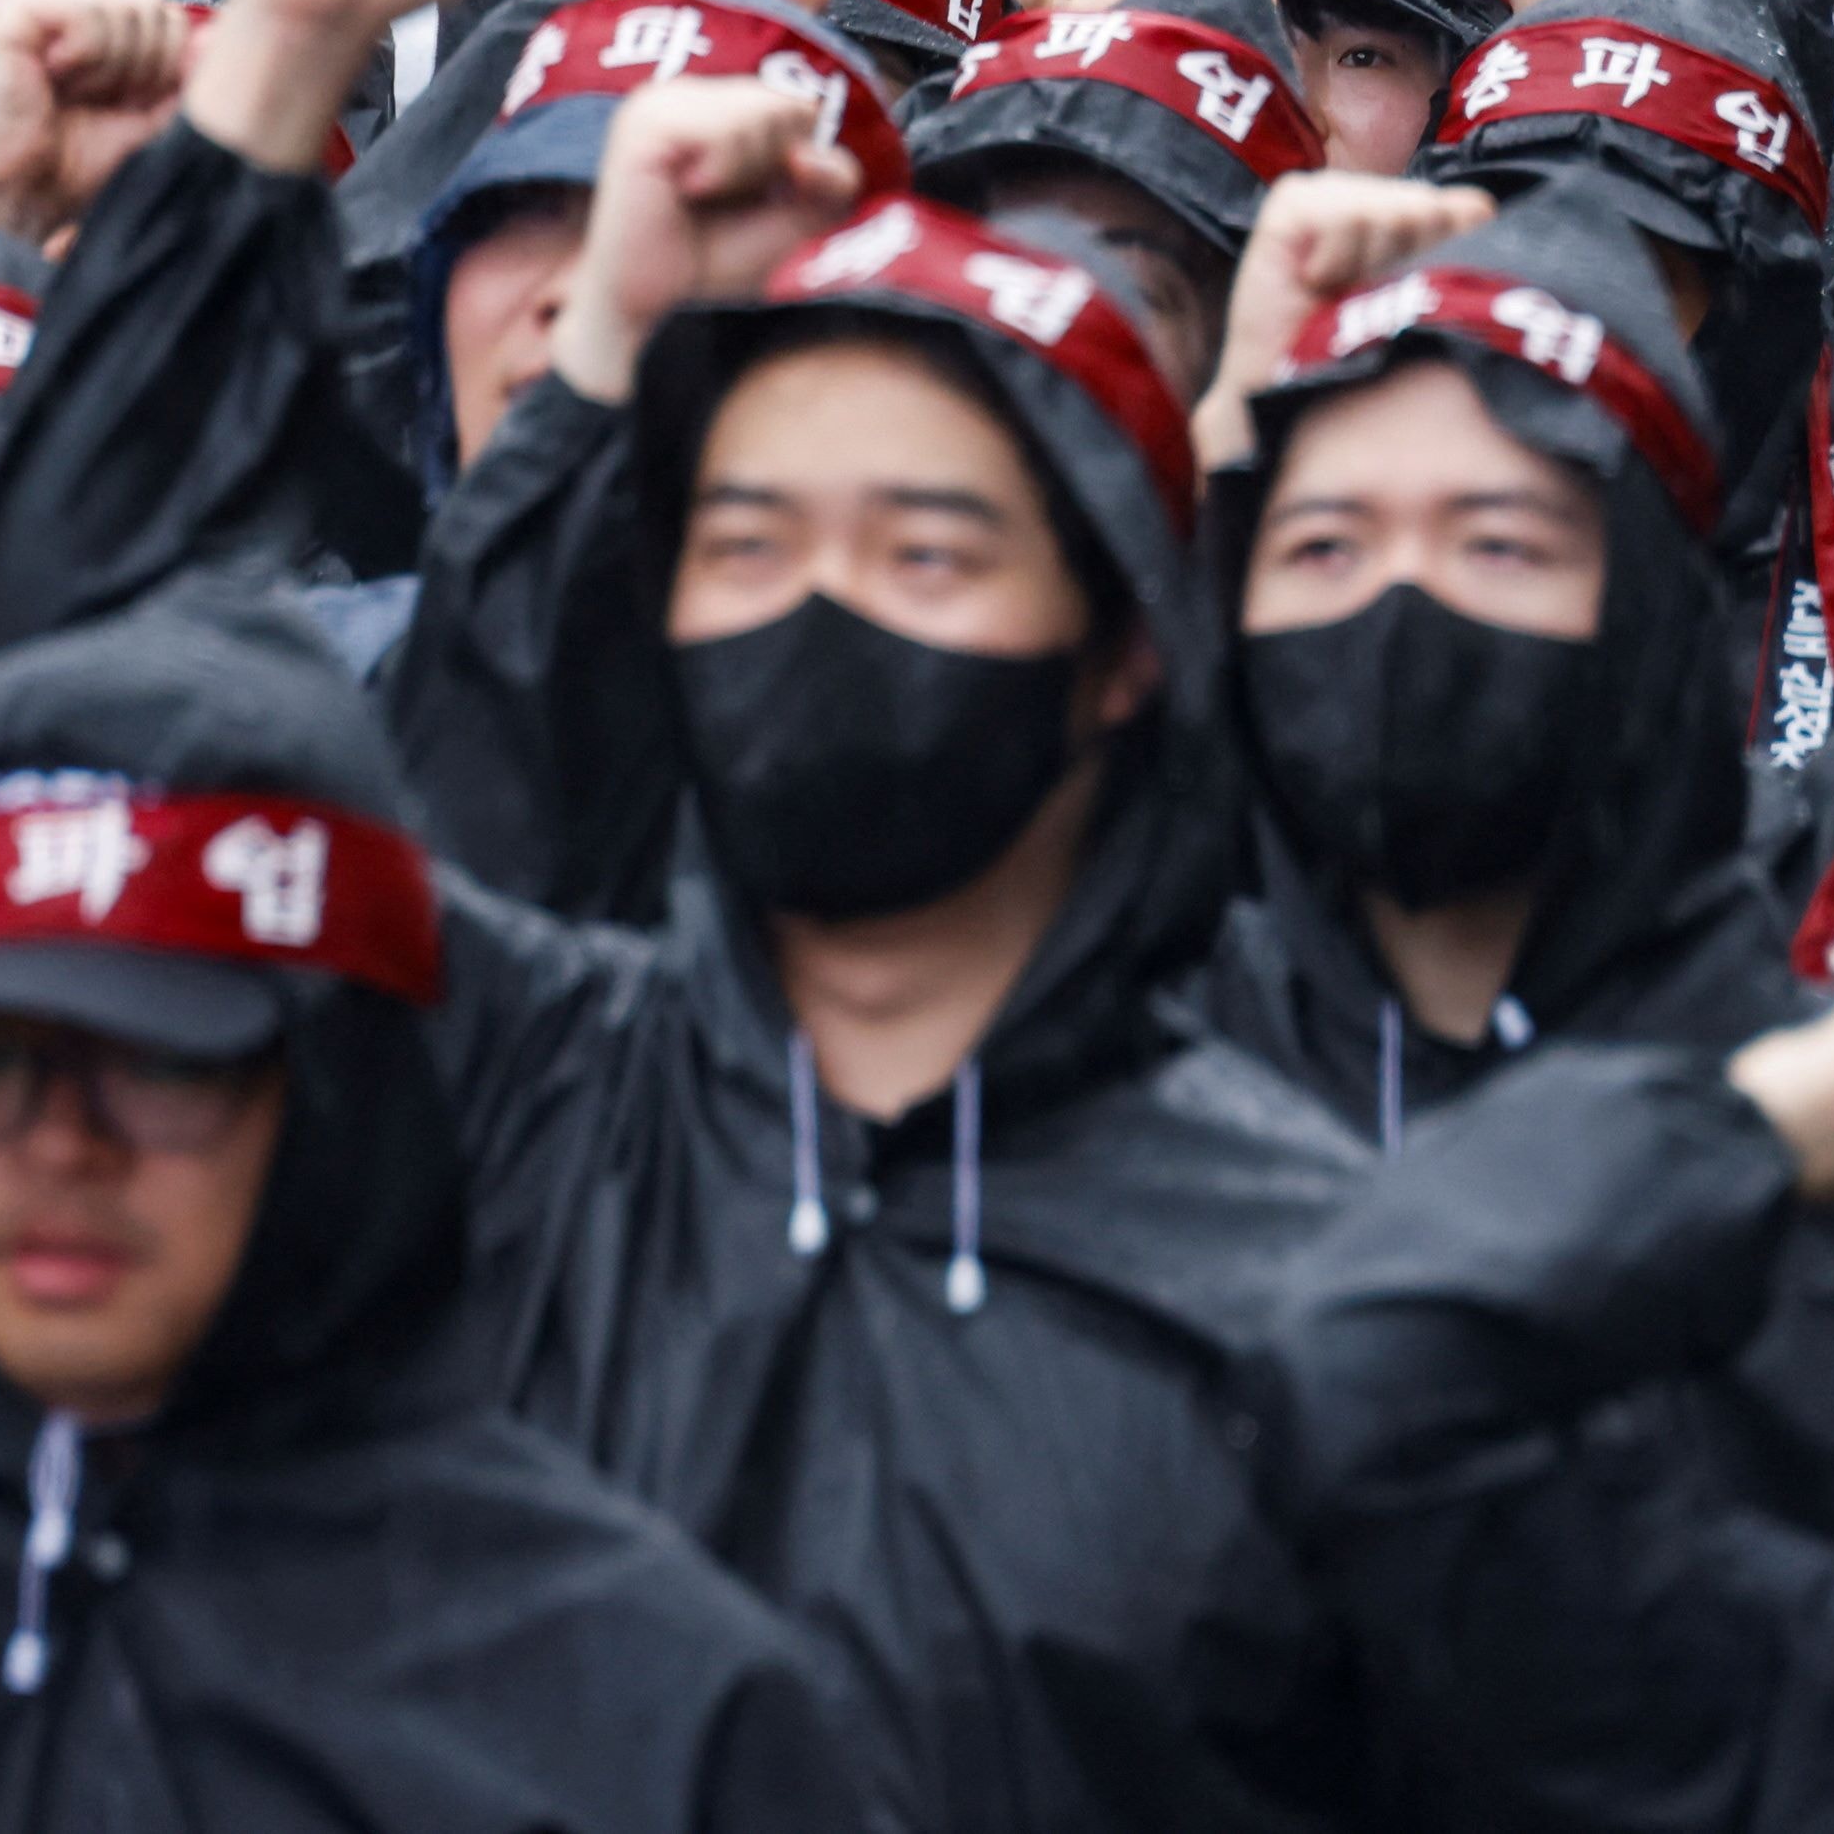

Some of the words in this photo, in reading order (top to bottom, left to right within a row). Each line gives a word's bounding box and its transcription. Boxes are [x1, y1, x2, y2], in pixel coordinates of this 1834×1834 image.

[1461, 34, 1792, 173] 총파업
[795, 199, 1099, 348] 파업
[1330, 270, 1607, 386] 파업
